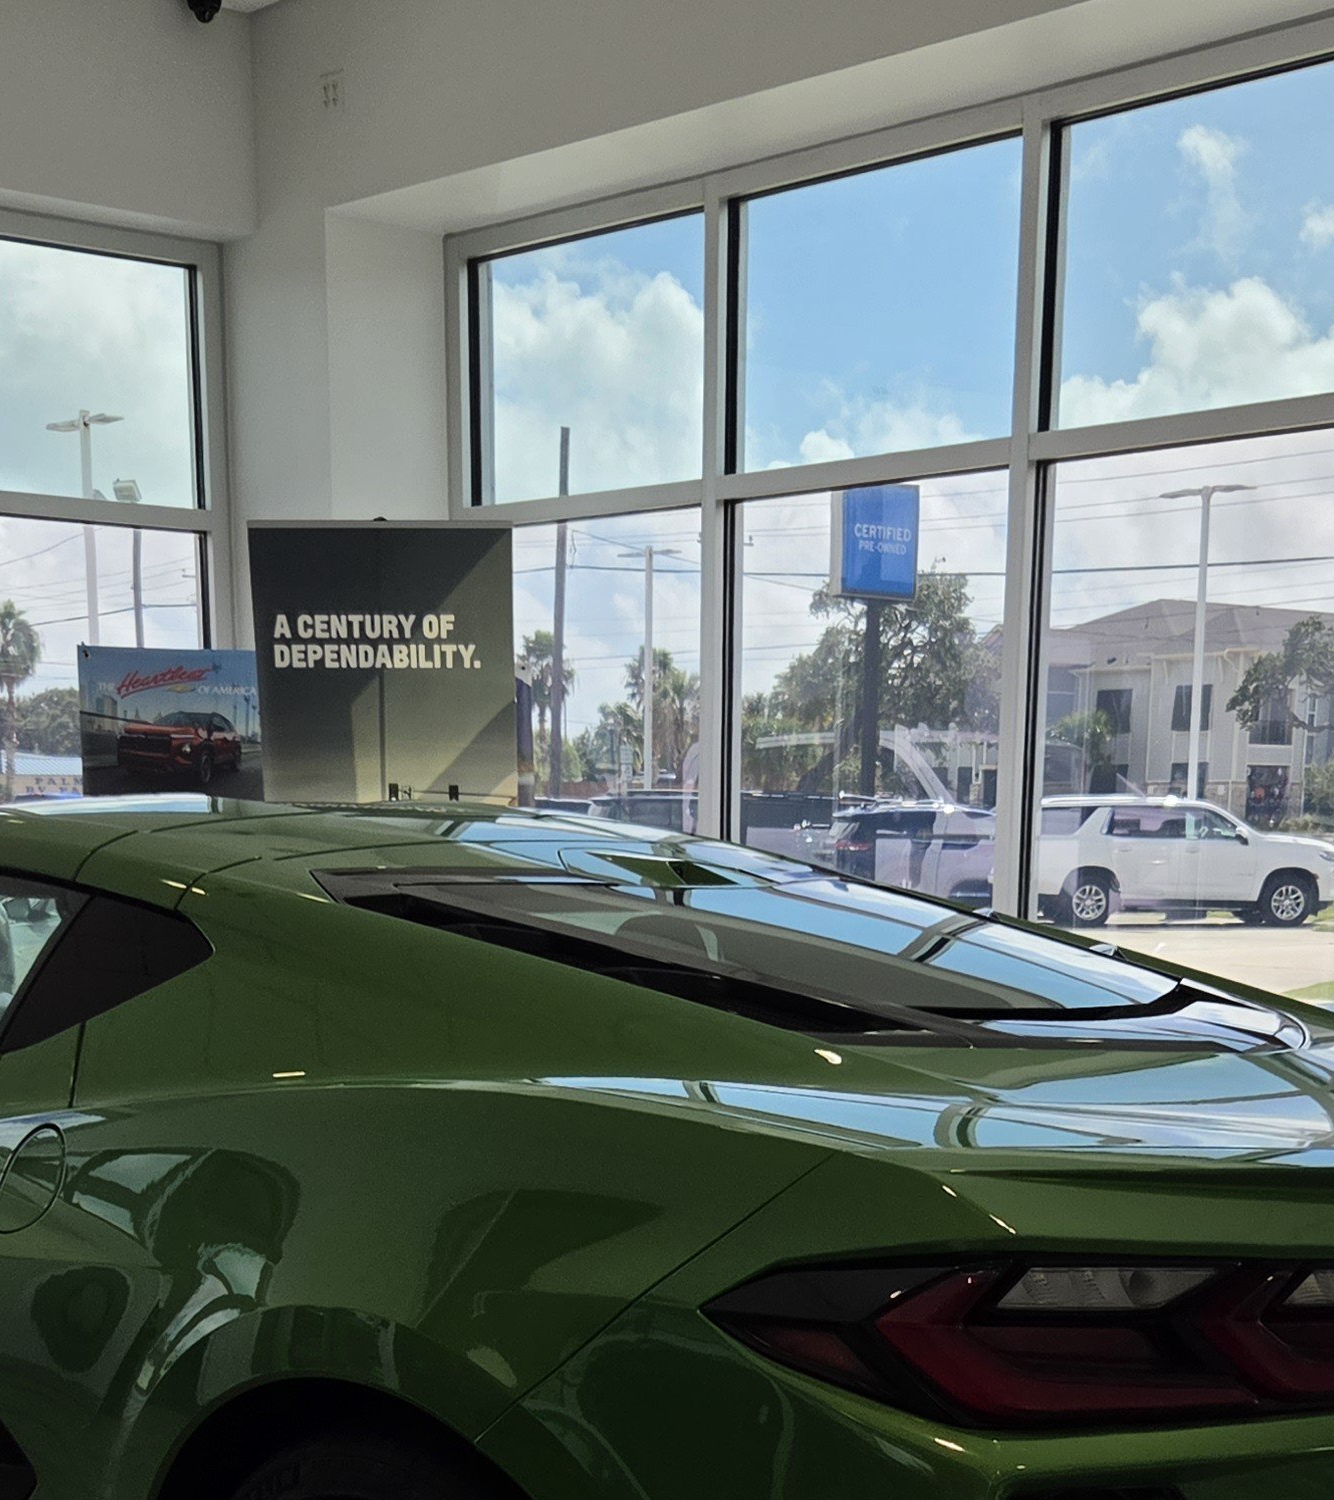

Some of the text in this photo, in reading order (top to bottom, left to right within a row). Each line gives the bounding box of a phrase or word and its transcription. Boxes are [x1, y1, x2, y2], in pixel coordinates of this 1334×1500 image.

[854, 523, 912, 542] CERTIFIED
[858, 540, 907, 556] PRE-OWNED
[274, 614, 455, 639] A CENTURY OF
[274, 644, 481, 669] DEPENDABILITY.
